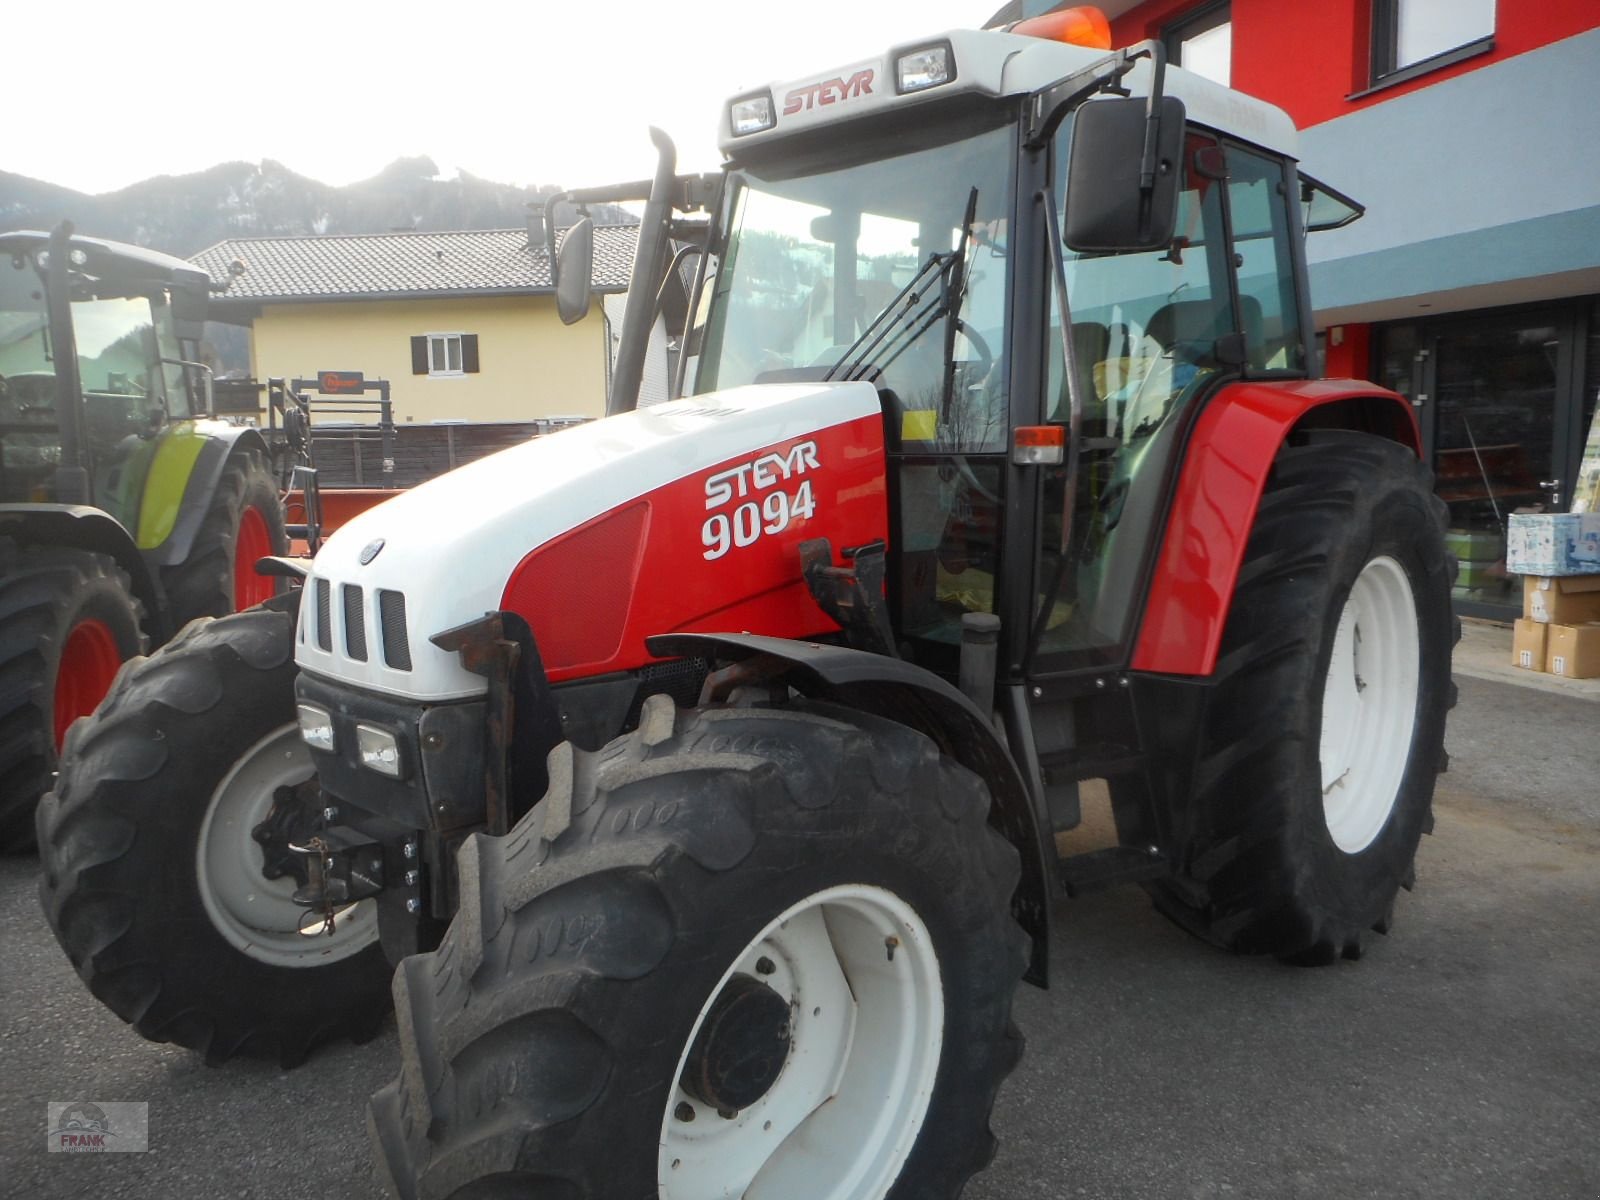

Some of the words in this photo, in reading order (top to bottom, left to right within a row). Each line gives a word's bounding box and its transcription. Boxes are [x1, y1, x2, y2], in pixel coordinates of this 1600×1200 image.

[783, 68, 874, 115] STEYR
[704, 440, 821, 511] STEYR
[701, 479, 816, 561] 9094
